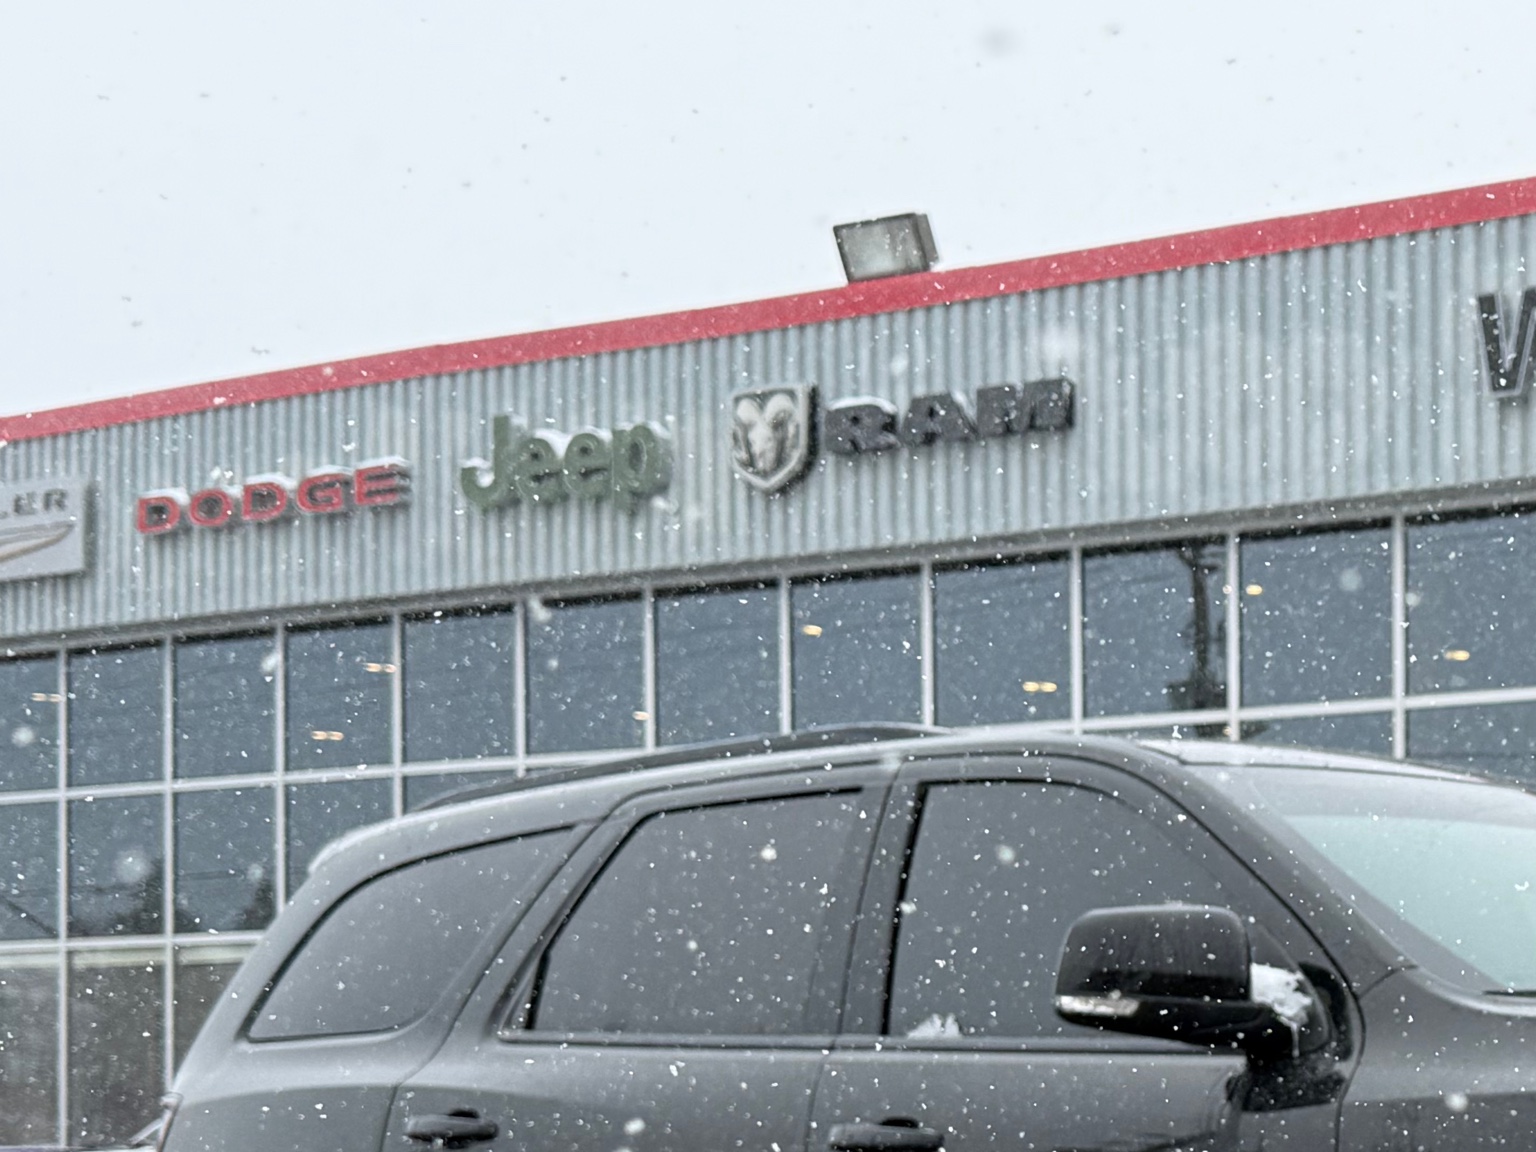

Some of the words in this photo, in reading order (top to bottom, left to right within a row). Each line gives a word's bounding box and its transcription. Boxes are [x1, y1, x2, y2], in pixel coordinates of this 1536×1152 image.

[824, 380, 1074, 454] RAM
[136, 462, 406, 534] DODGE
[461, 415, 670, 514] Jeep
